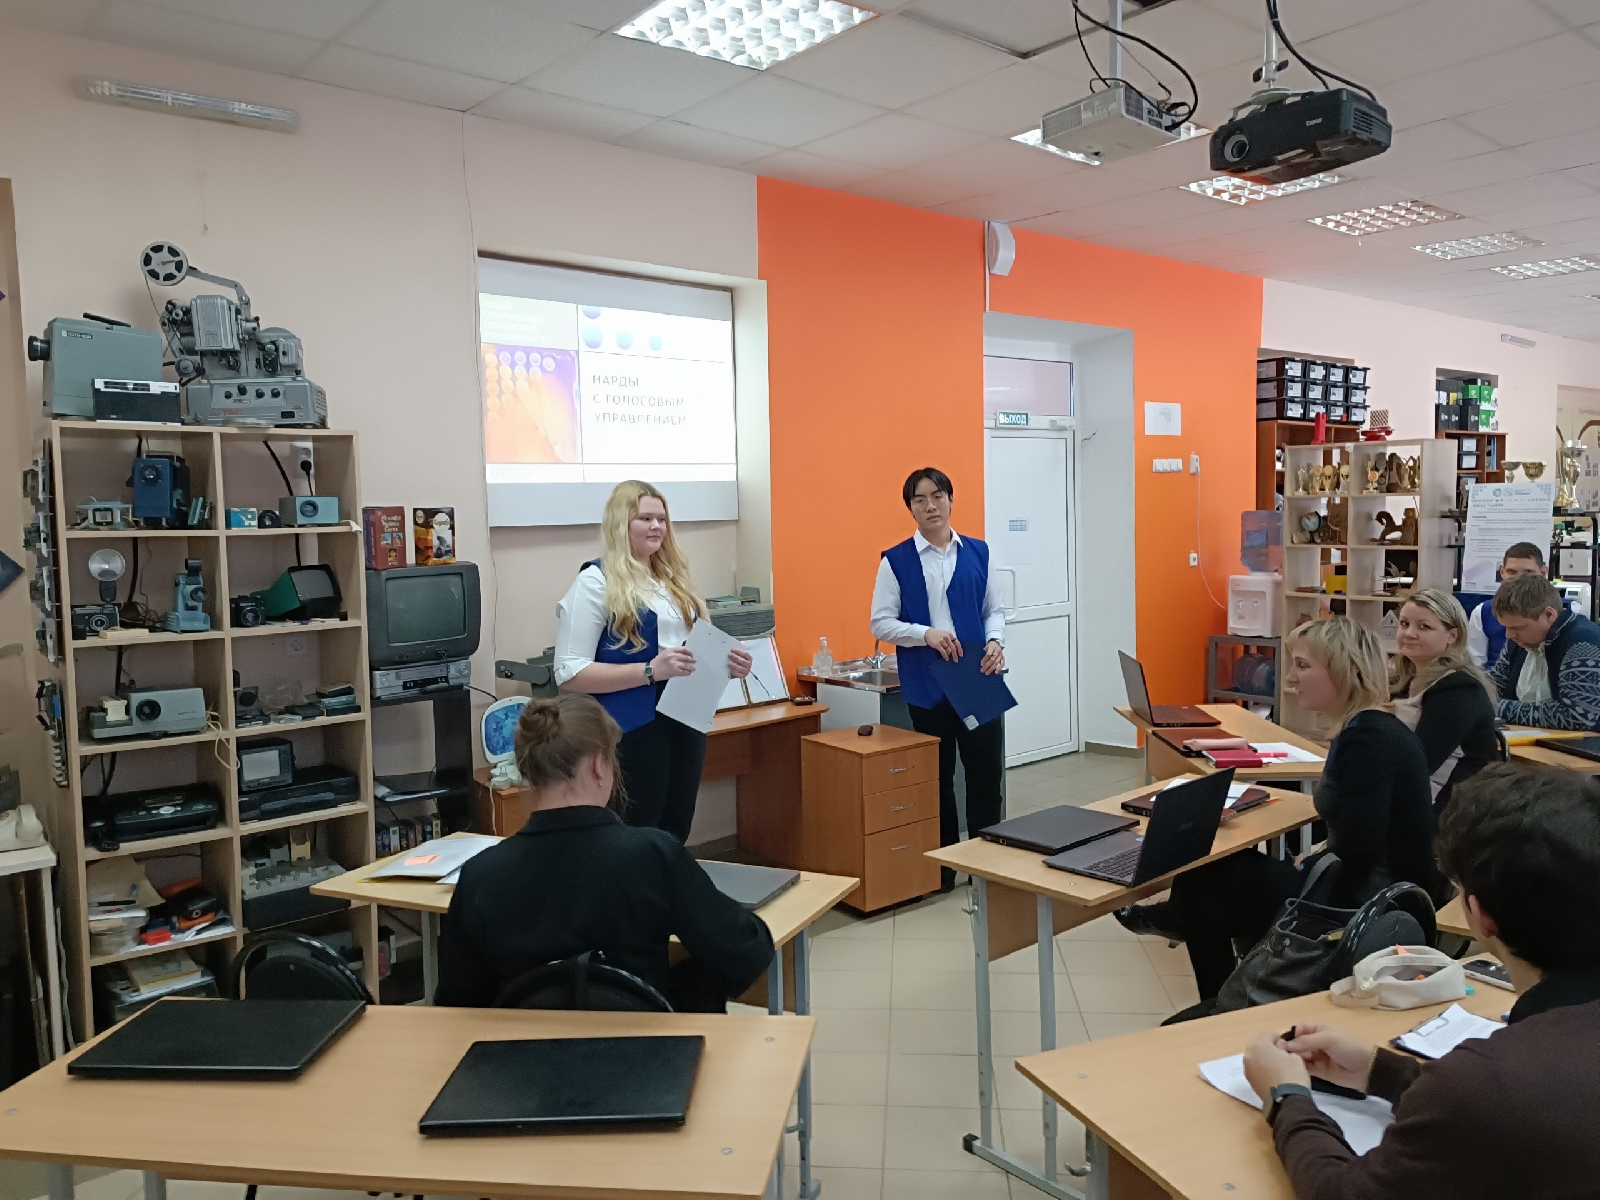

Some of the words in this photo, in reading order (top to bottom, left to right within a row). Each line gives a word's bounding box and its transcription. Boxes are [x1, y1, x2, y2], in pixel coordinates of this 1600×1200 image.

[592, 374, 639, 388] НАРДЫ
[593, 393, 601, 404] С
[606, 394, 684, 407] ГОЛОСОВЫМ
[595, 412, 688, 426] УПРАВЛЕНИЕМ
[999, 413, 1026, 425] ВЫХОД
